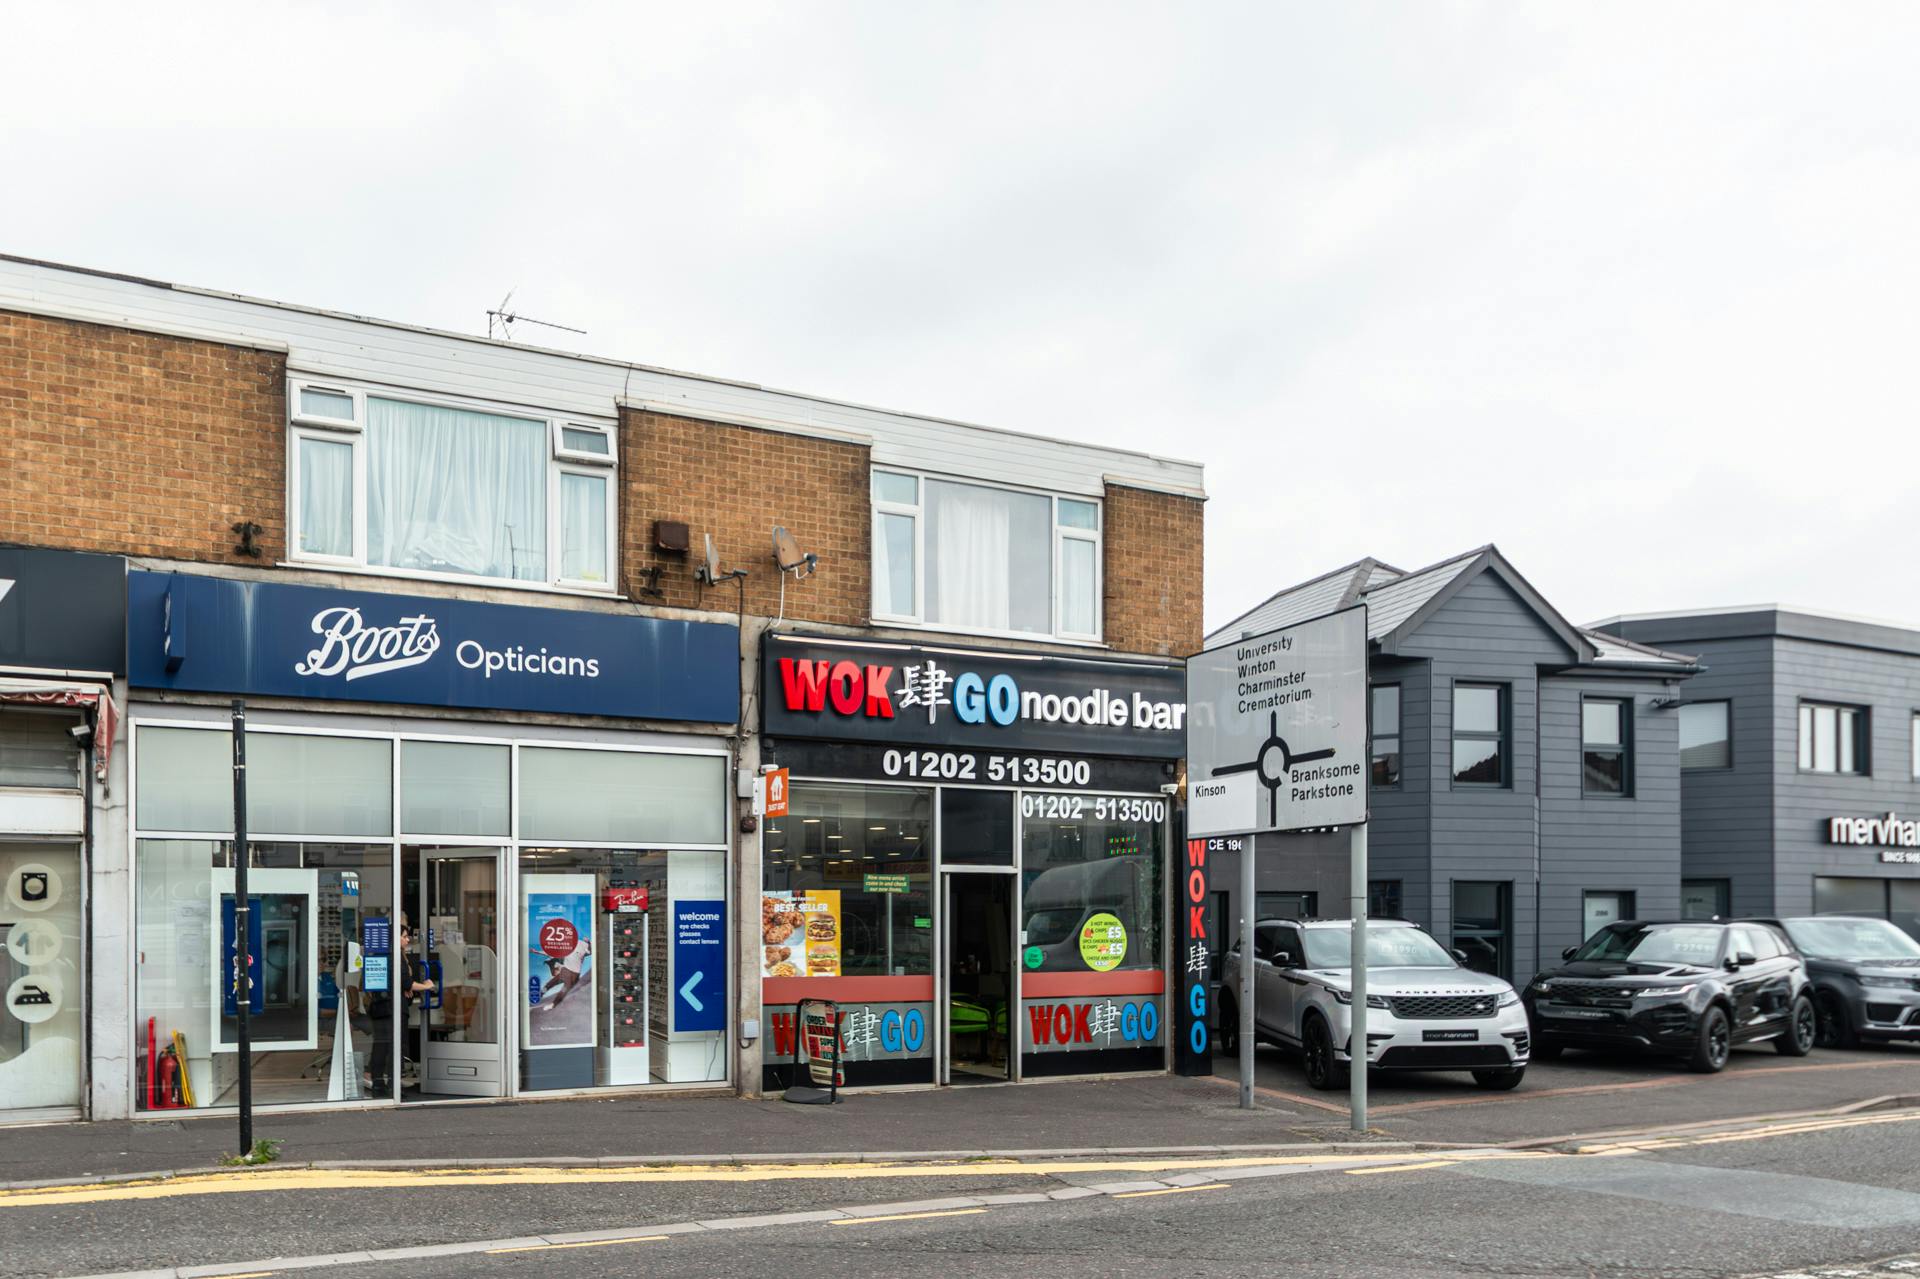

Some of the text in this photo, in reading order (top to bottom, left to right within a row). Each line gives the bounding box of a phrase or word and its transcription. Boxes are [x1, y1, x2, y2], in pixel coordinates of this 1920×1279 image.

[295, 607, 599, 682] Boots Opticians
[1237, 636, 1293, 662] University
[1238, 659, 1276, 679] Winton
[779, 657, 895, 719] WOK
[953, 671, 1020, 726] GO
[1022, 688, 1128, 727] noodle
[1133, 692, 1186, 731] bar
[1238, 670, 1306, 697] Charminster
[1238, 687, 1312, 714] Crematorium
[883, 749, 1091, 785] 01202 513500
[1292, 762, 1360, 783] Branksome
[1195, 784, 1226, 798] Kinson
[1292, 783, 1354, 802] Parkstone
[1022, 795, 1164, 823] 01202 513500
[1831, 812, 1920, 847] mervha
[1188, 840, 1206, 939] WOK
[679, 912, 720, 921] welcome
[774, 903, 828, 913] BEST SELLER
[881, 1009, 924, 1053] GO
[1029, 1004, 1092, 1045] WOK
[1121, 1001, 1158, 1041] GO
[1190, 984, 1207, 1054] GO
